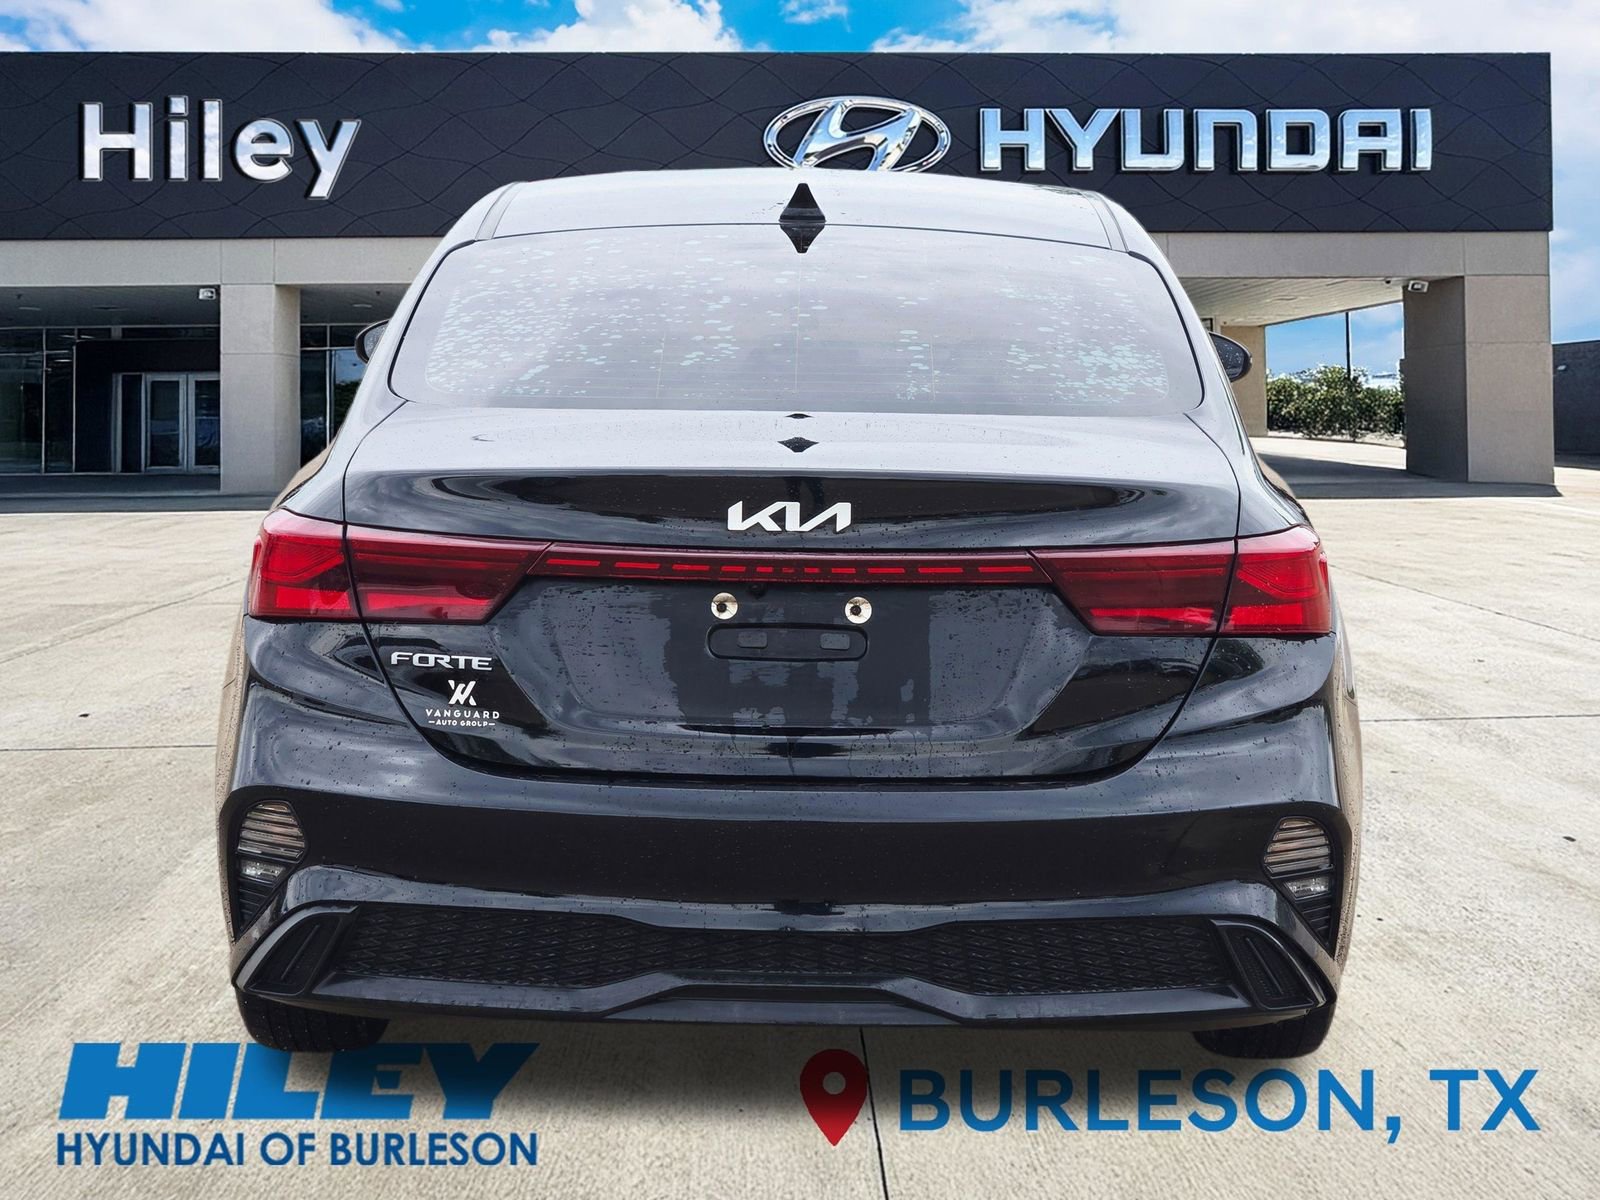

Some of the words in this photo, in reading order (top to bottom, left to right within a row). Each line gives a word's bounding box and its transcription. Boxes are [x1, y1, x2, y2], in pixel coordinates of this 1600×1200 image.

[79, 95, 362, 200] Hiley
[979, 107, 1434, 173] HYUNDAI
[727, 500, 852, 533] KIA
[390, 651, 493, 671] FORTE
[425, 708, 500, 720] VANGUARD
[435, 718, 458, 727] AUTO
